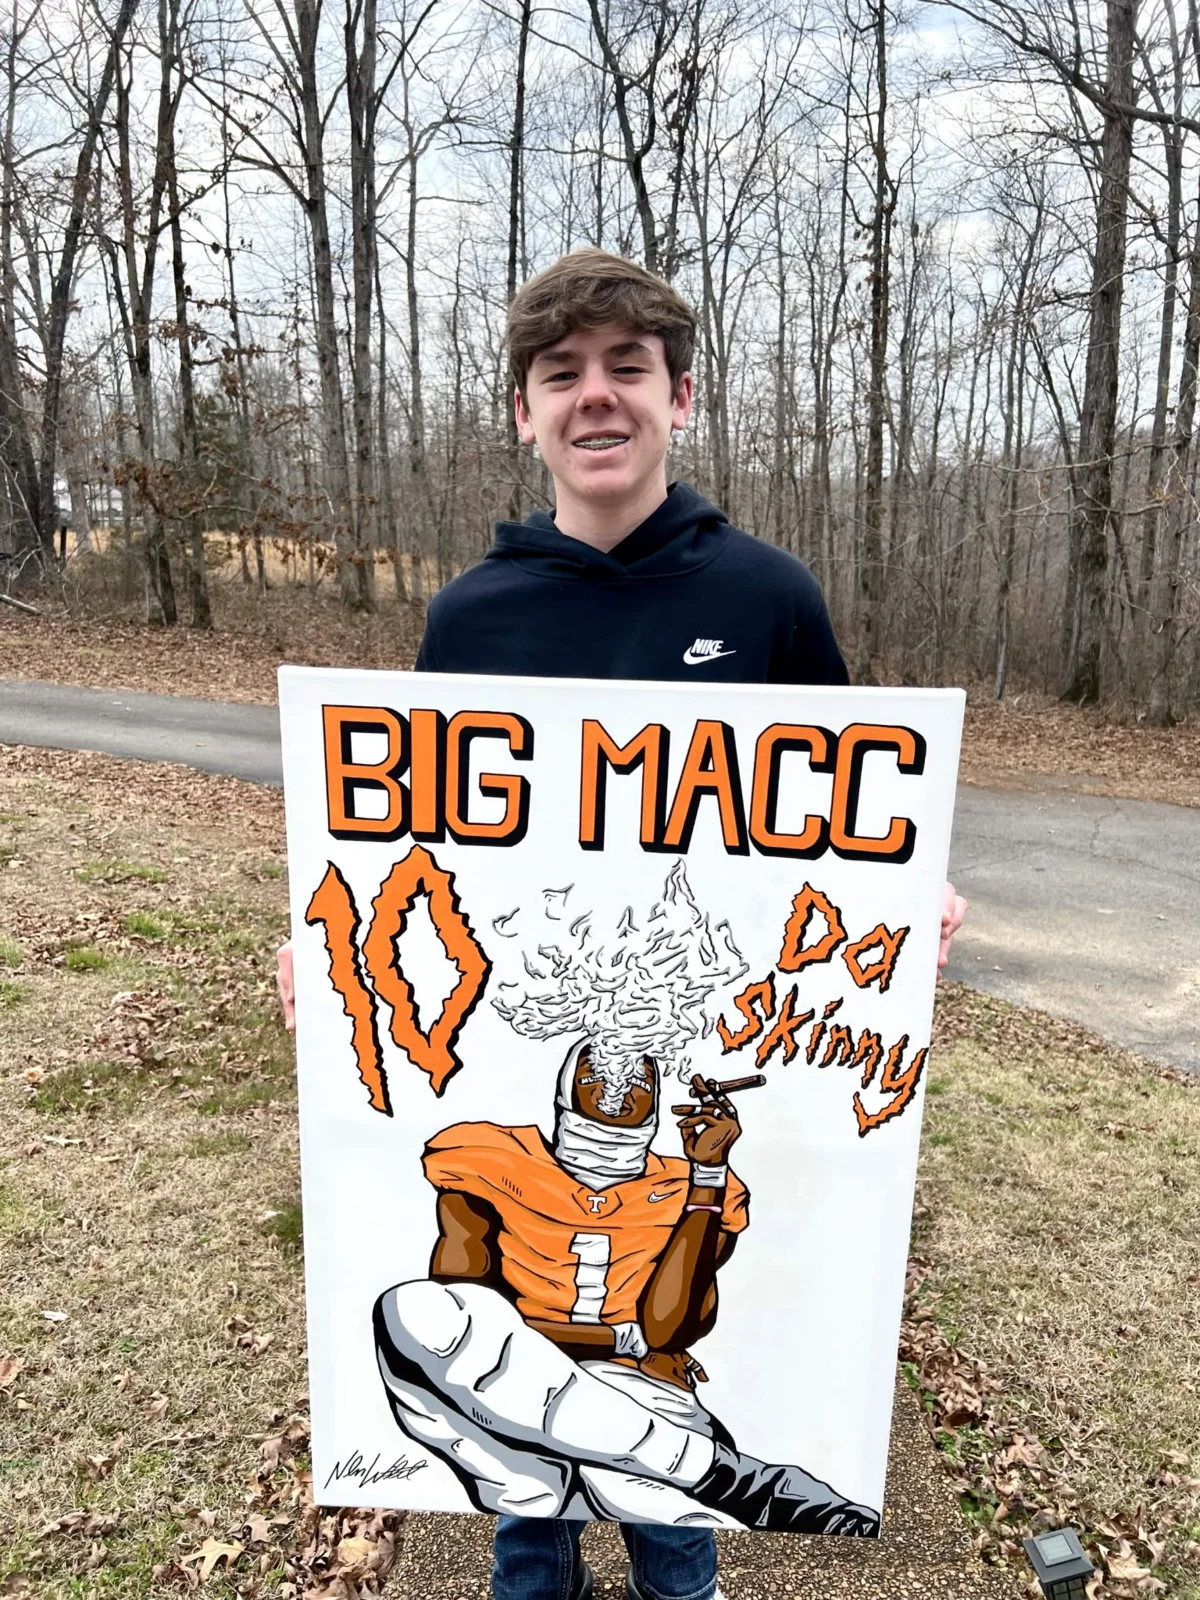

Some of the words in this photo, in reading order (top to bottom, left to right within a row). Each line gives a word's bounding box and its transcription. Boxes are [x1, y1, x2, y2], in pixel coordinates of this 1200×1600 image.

[691, 638, 724, 655] NIKE
[322, 704, 534, 847] BIG
[578, 719, 926, 864] MACC
[305, 845, 493, 1116] 10
[776, 881, 910, 994] Da
[716, 971, 929, 1138] Skinny
[587, 1195, 607, 1213] T
[568, 1231, 612, 1324] 1
